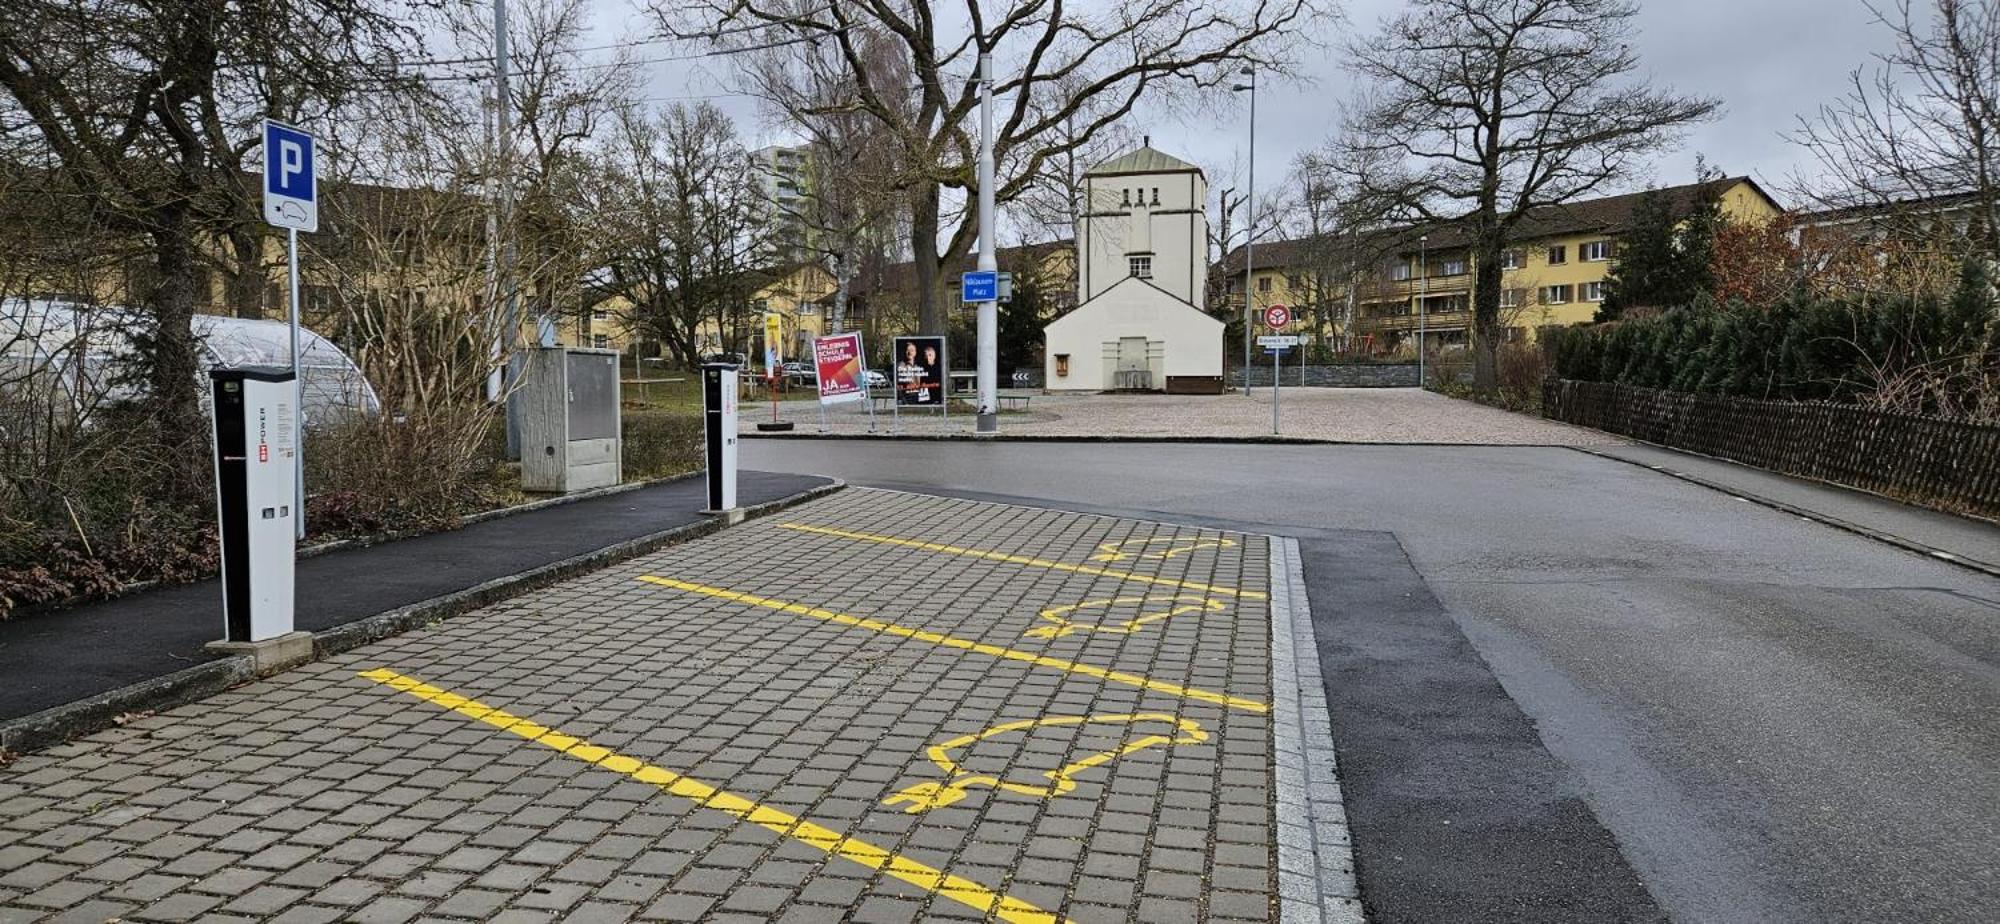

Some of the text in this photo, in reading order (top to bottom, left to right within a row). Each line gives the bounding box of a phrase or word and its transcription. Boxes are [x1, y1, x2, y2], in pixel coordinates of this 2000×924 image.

[280, 139, 302, 188] P
[823, 379, 839, 391] JA
[918, 387, 930, 397] JA
